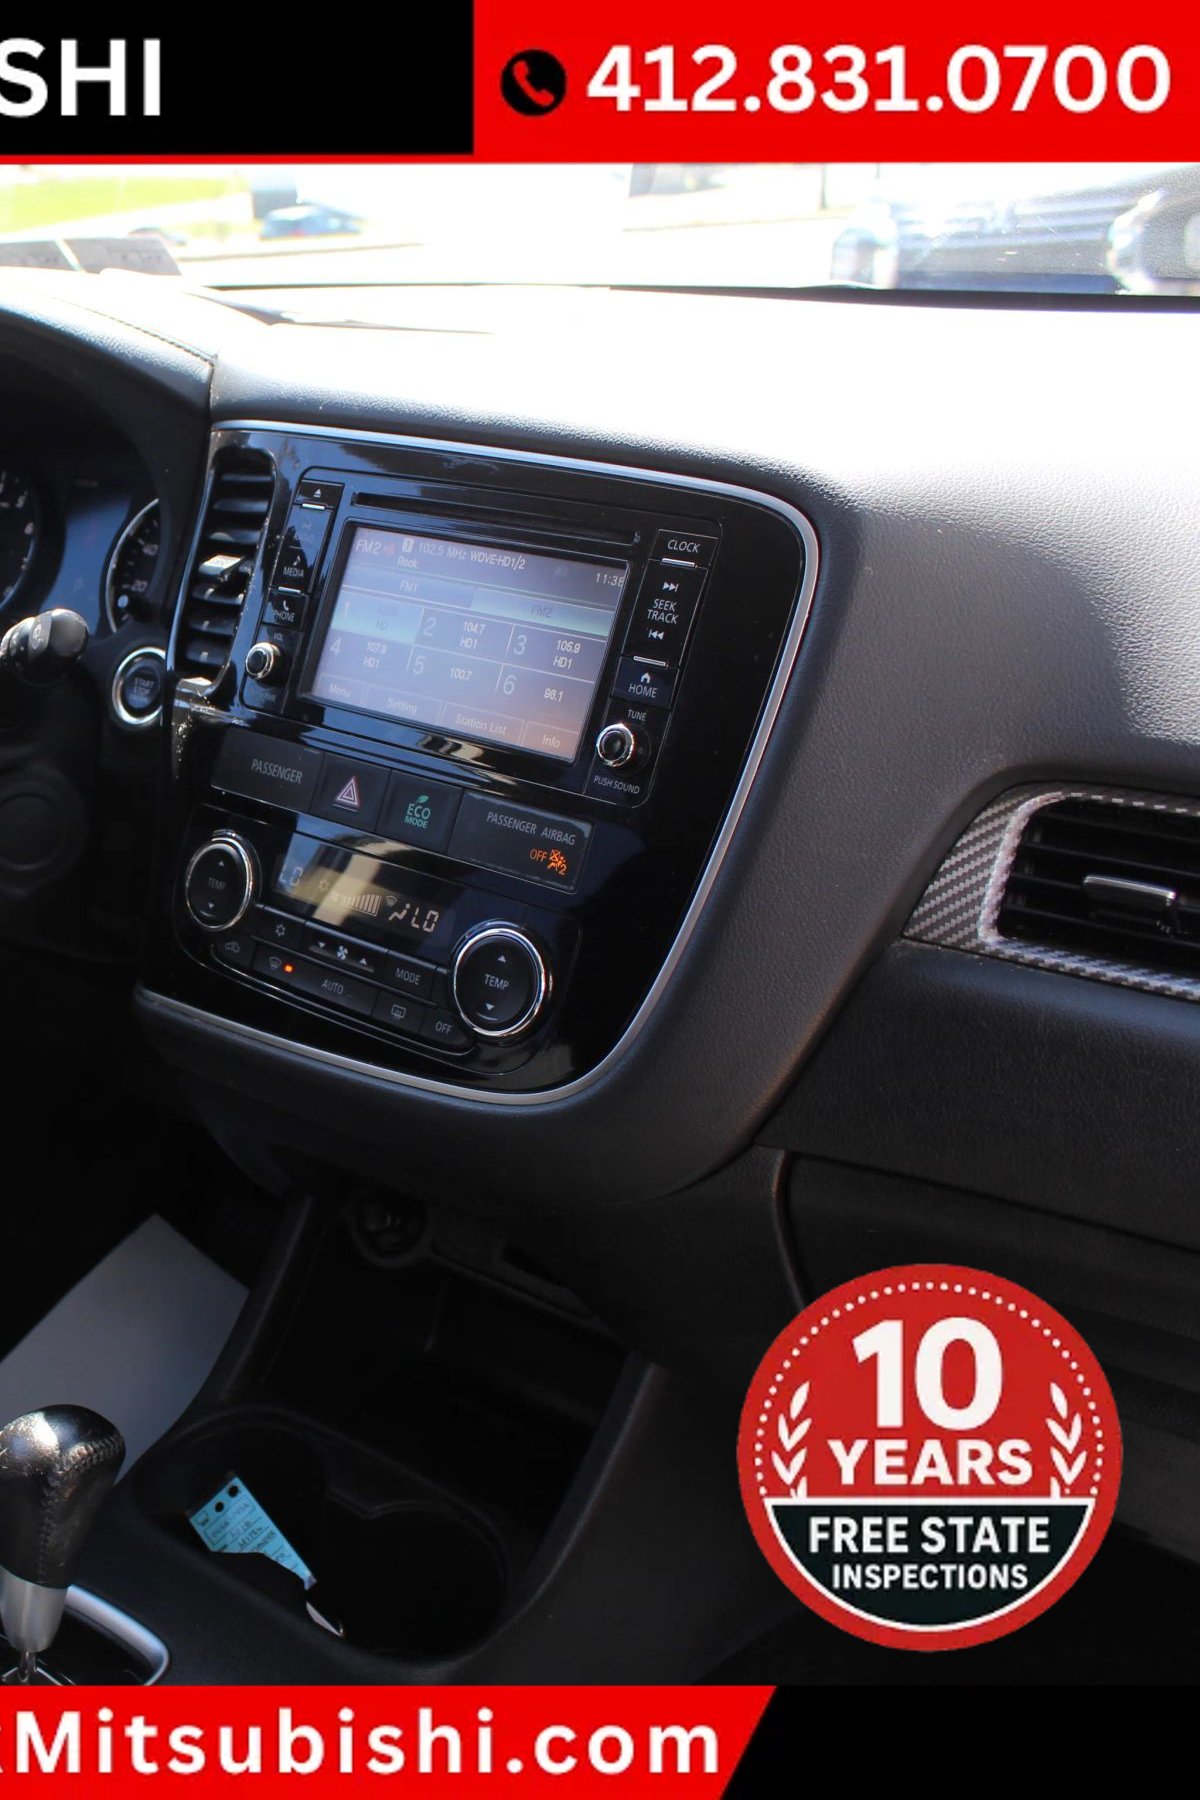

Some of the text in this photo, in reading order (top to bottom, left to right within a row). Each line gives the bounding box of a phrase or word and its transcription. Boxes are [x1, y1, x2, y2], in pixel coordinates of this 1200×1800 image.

[142, 543, 159, 556] 40
[355, 538, 382, 554] FM2
[446, 547, 470, 561] MHz
[667, 539, 701, 553] CLOCK
[283, 566, 305, 579] MEDIA
[596, 573, 625, 588] 11:38
[131, 580, 149, 592] 20
[530, 604, 553, 618] FM2
[652, 598, 678, 612] SEEK
[273, 610, 296, 624] PHONE
[646, 608, 680, 625] TRACK
[423, 617, 437, 637] 2
[463, 620, 486, 635] 104.7
[330, 637, 343, 657] 4
[459, 637, 478, 650] HD1
[513, 634, 528, 656] 3
[412, 655, 426, 676] 5
[552, 655, 573, 670] HD1
[328, 682, 352, 698] Menu
[503, 674, 517, 696] 6
[628, 684, 658, 699] HOME
[386, 697, 418, 715] Setting
[626, 709, 647, 722] TUNE
[455, 712, 508, 737] Station List
[542, 733, 561, 749] Info
[250, 758, 303, 785] PASSENGER
[593, 774, 640, 795] PUSH SOUND
[406, 802, 431, 820] ECO
[404, 815, 428, 830] MODE
[486, 811, 576, 846] PASSENGER AIRBAG
[529, 848, 548, 863] OFF
[207, 876, 227, 892] TEMP
[395, 967, 422, 986] MODE
[484, 973, 510, 991] TEMP
[321, 978, 345, 996] AUTO
[435, 1020, 453, 1035] OFF
